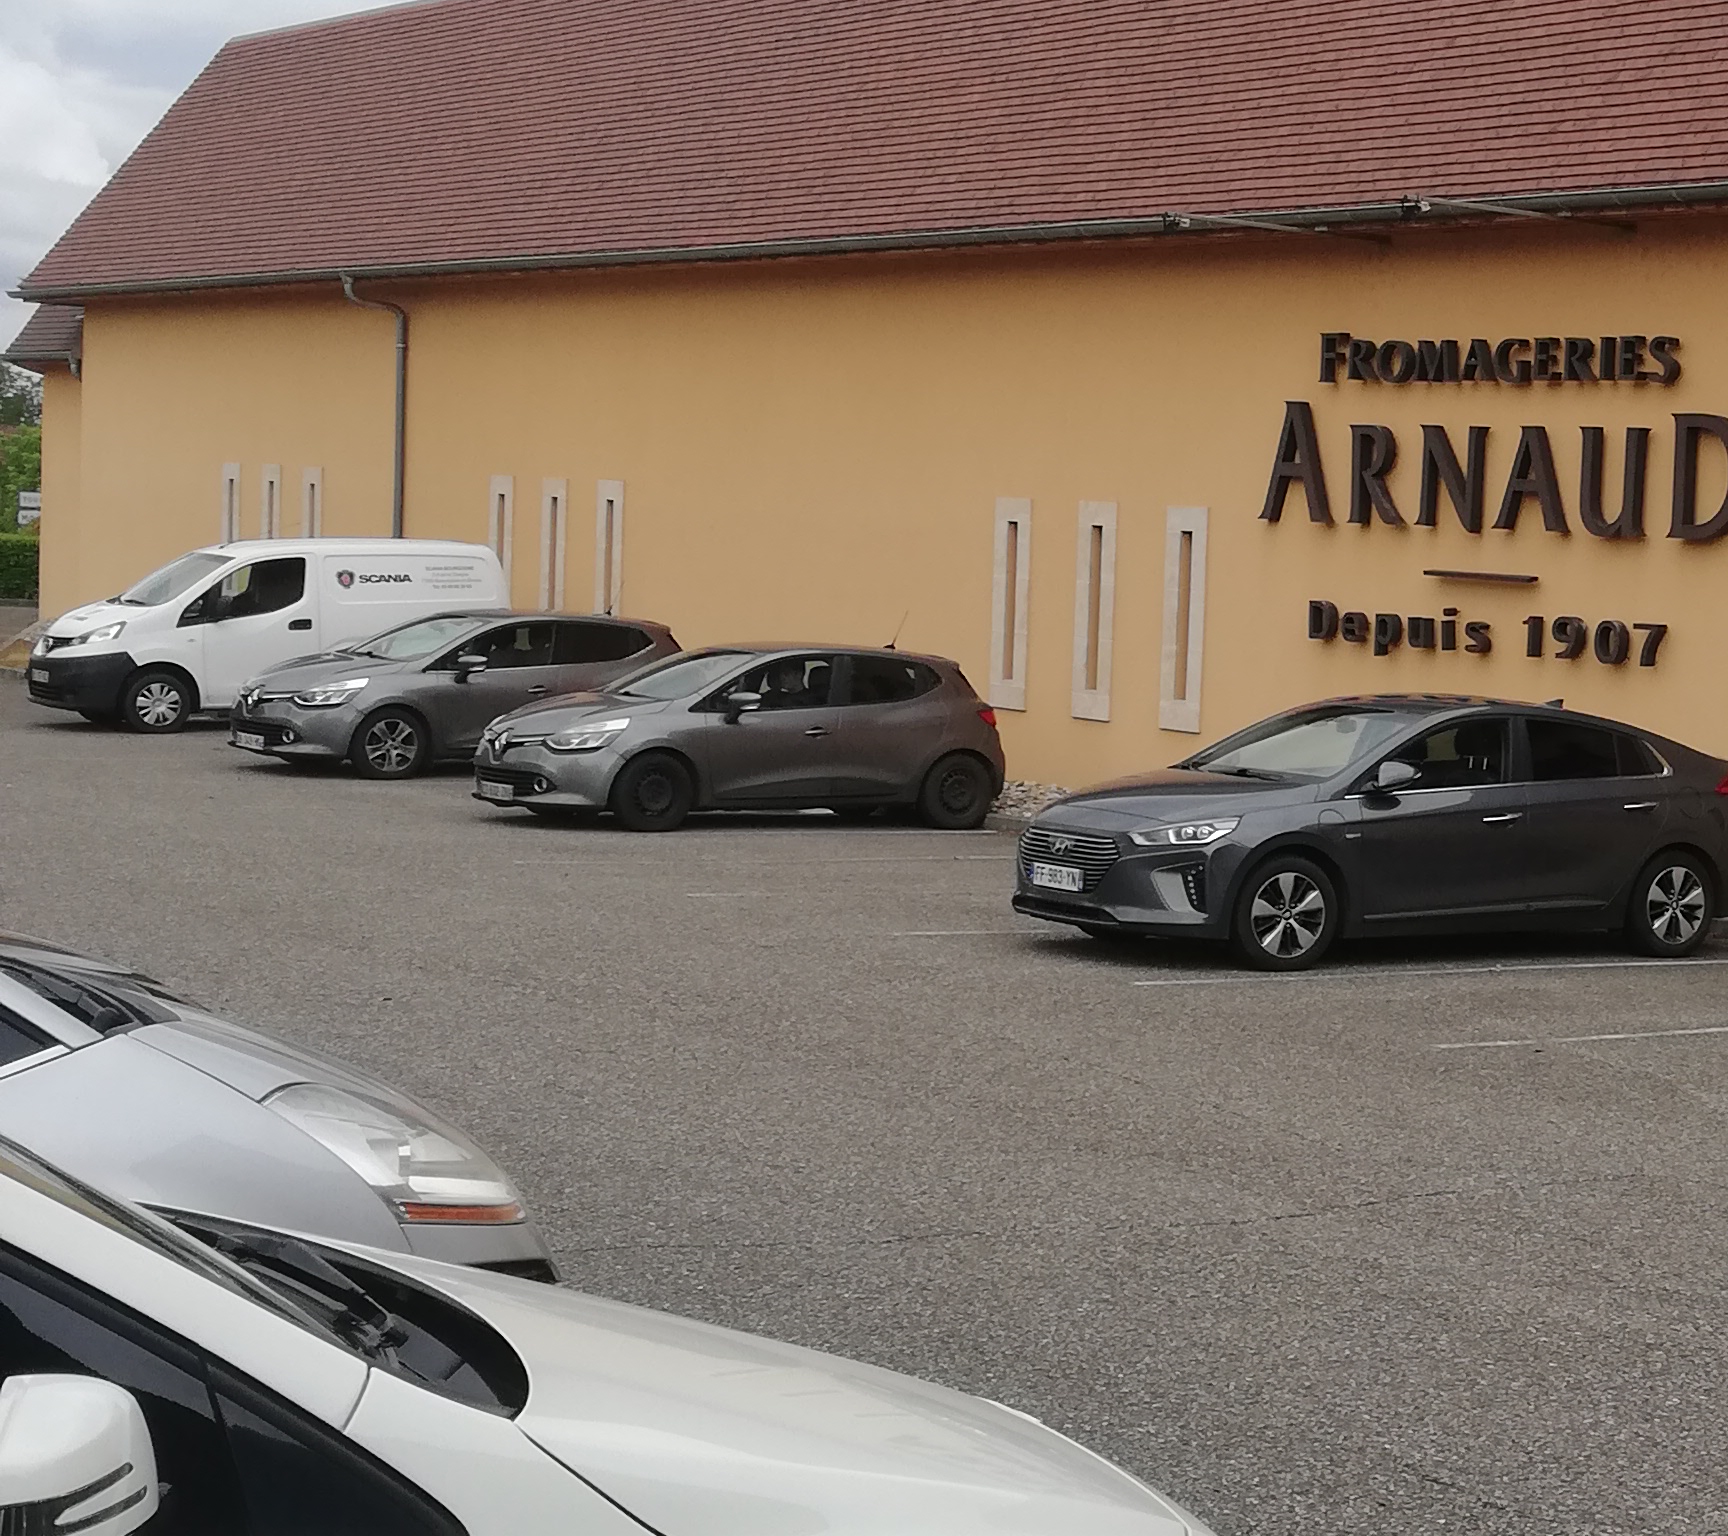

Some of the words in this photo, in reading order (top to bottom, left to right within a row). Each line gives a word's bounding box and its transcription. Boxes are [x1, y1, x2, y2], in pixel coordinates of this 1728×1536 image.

[1318, 332, 1682, 384] FROMAGERIES
[358, 574, 412, 584] SCANIA
[1308, 600, 1492, 656] Depuis
[1522, 615, 1668, 667] 1907
